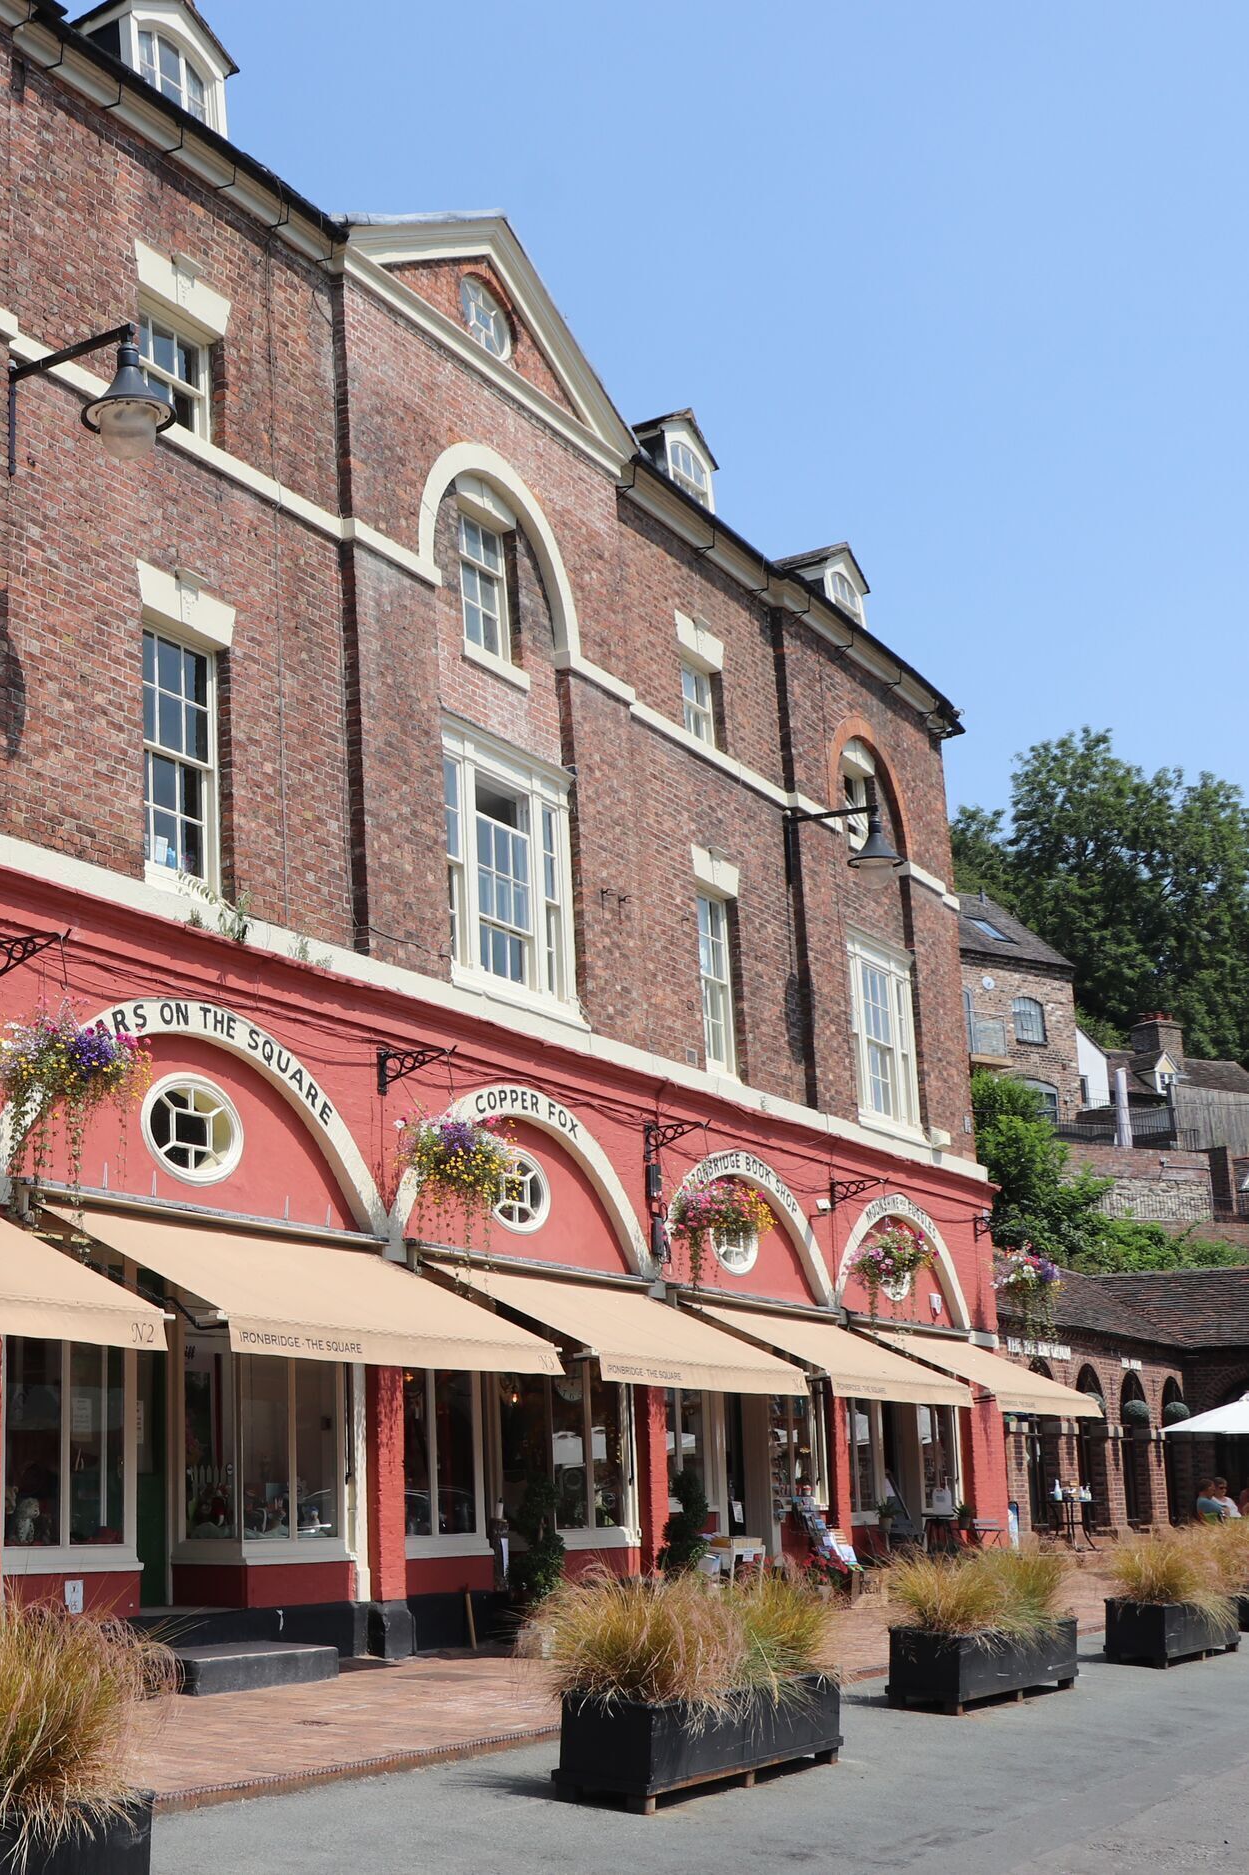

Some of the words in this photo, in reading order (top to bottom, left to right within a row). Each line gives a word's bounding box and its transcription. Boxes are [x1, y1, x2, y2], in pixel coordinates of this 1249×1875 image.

[159, 1002, 190, 1026] ON
[199, 1006, 237, 1041] THE
[247, 1030, 333, 1127] SQUARE
[475, 1089, 540, 1114] COPPER
[548, 1101, 579, 1140] FOX
[745, 1156, 772, 1185] BOOK
[774, 1179, 798, 1214] SHOP
[239, 1331, 301, 1348] IRONBRIDGE
[305, 1338, 325, 1351] THE
[326, 1340, 363, 1354] SQUARE
